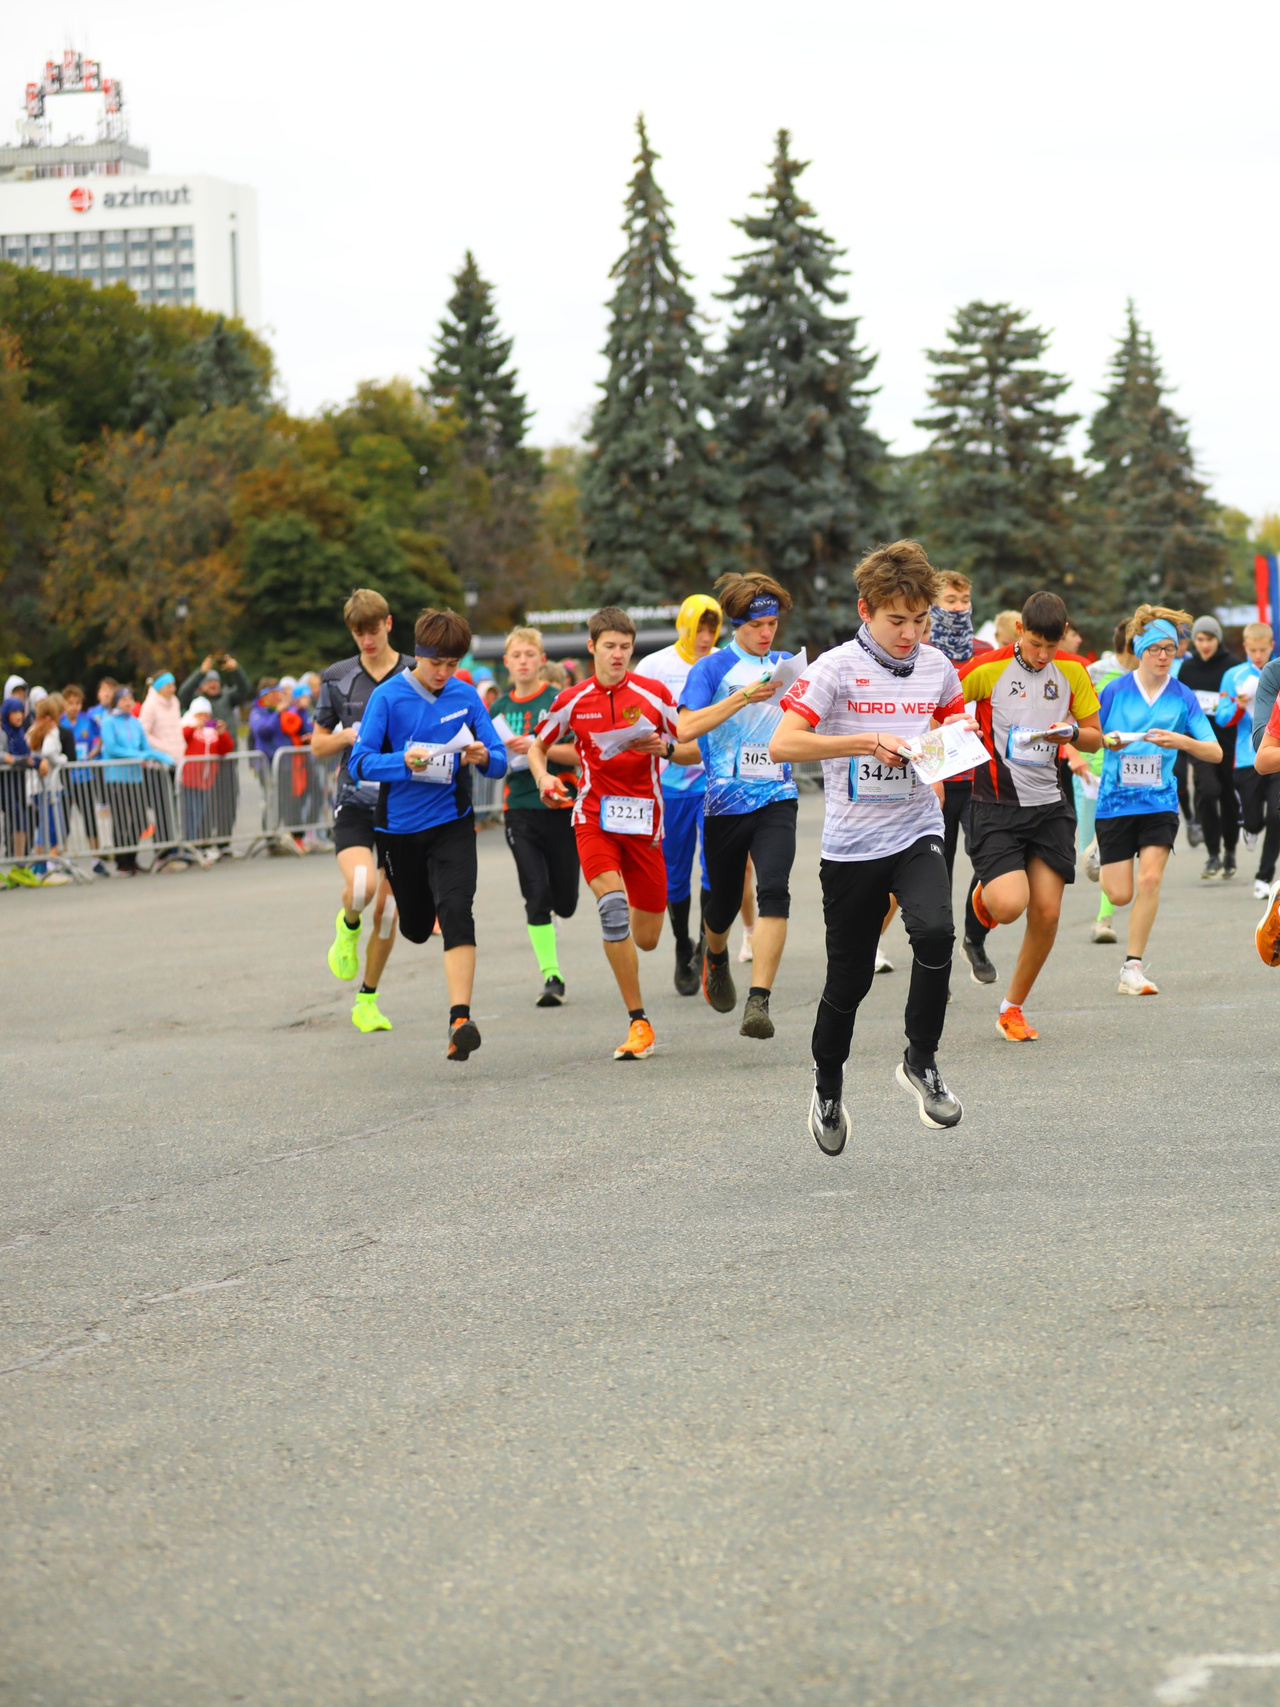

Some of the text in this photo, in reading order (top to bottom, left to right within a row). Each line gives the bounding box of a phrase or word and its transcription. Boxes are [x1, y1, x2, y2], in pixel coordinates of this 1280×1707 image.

[103, 185, 191, 208] azimut
[847, 700, 897, 715] NORD
[576, 712, 603, 720] RUSSIA
[741, 752, 777, 766] 305.
[858, 763, 909, 781] 342.1
[1123, 763, 1156, 775] 331.1
[607, 805, 645, 820] 322.1
